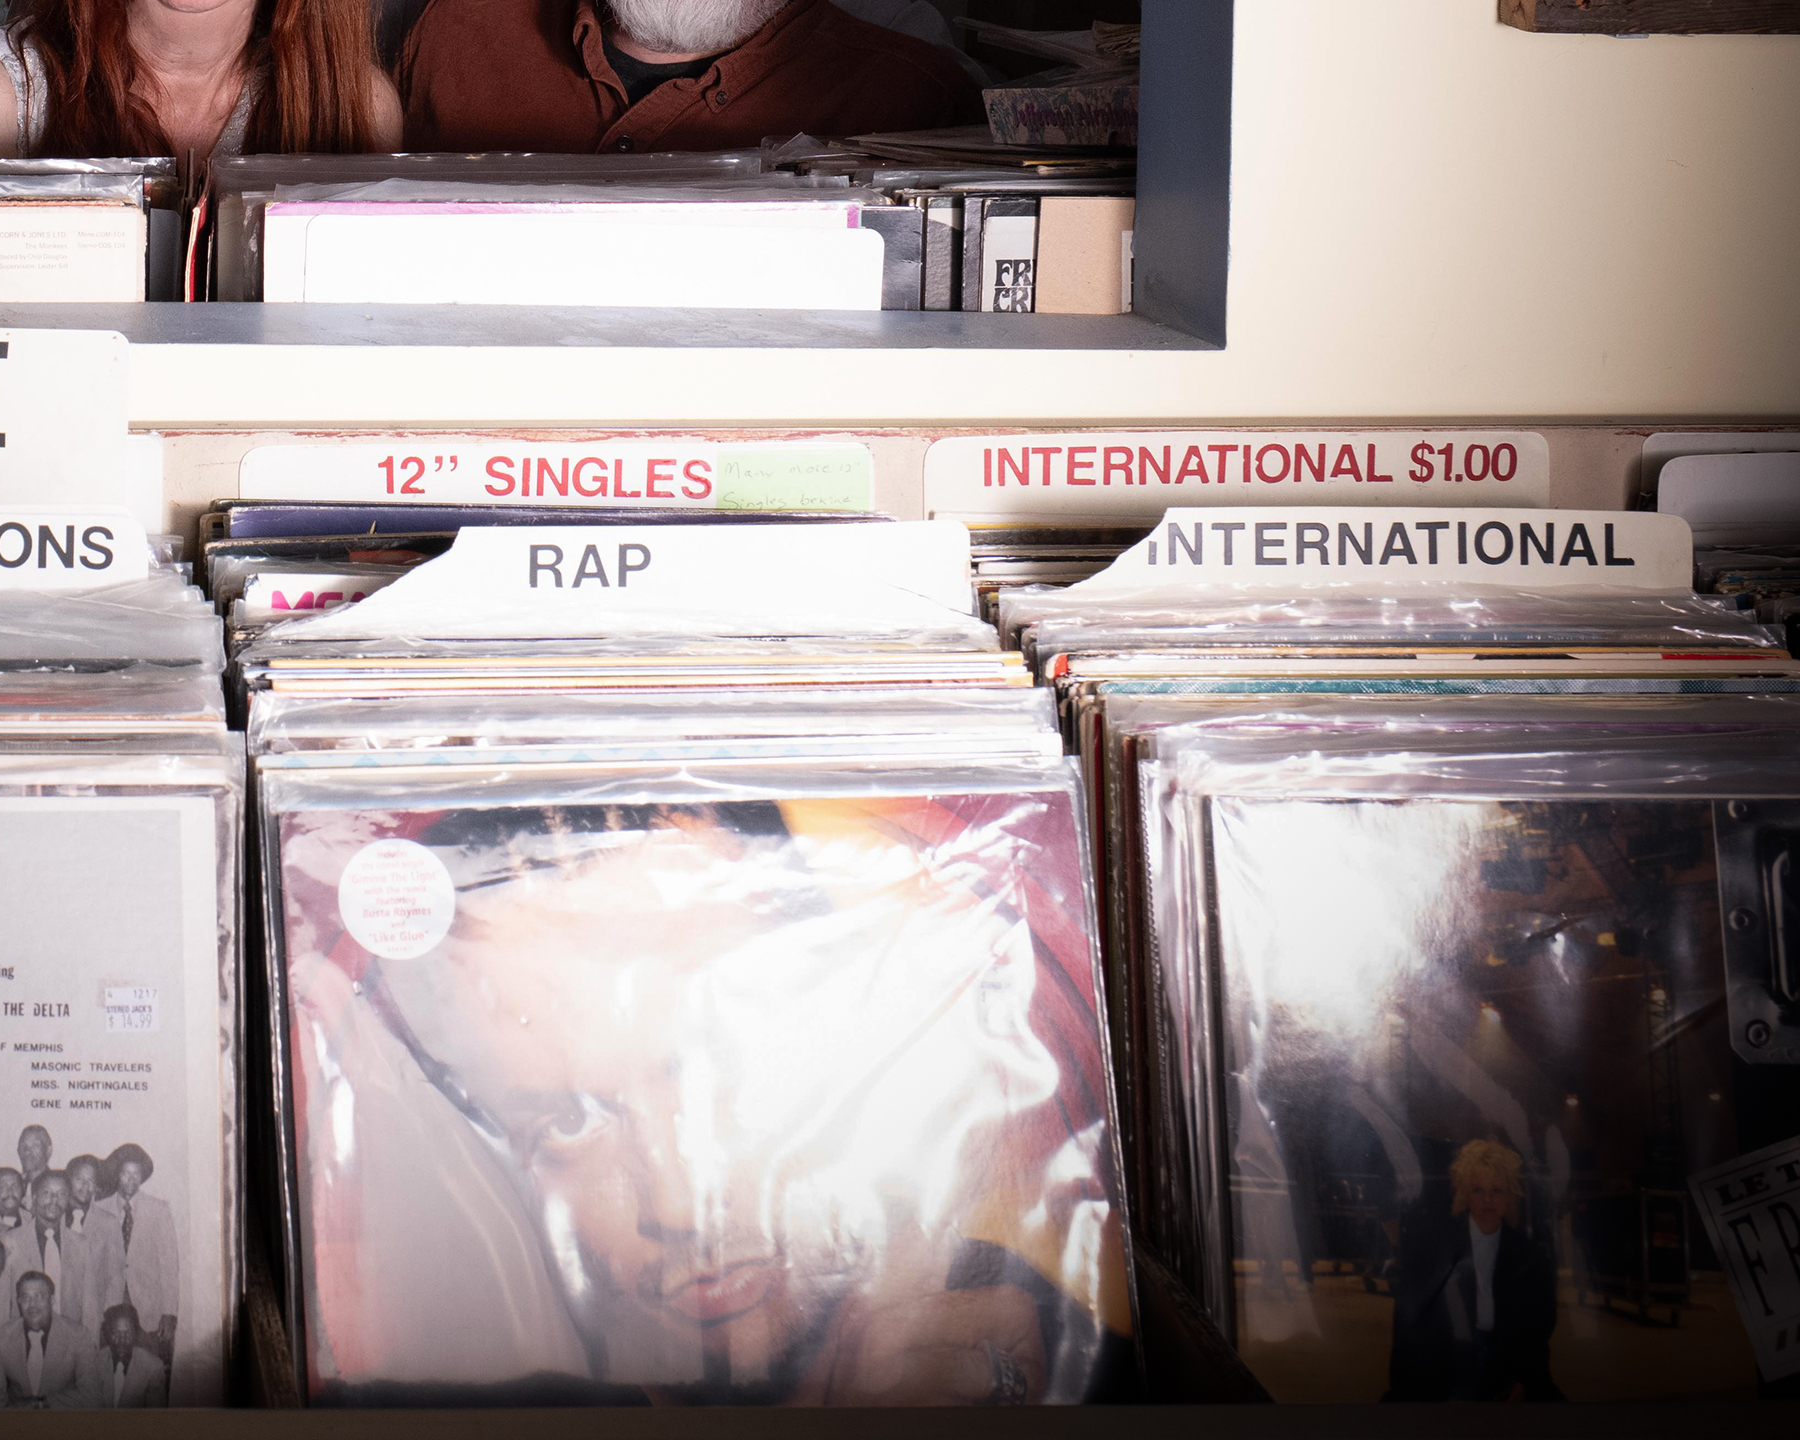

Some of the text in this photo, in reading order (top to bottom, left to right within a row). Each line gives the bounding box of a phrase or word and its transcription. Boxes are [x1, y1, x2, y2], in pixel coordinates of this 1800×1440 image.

[724, 461, 775, 479] Many
[982, 440, 1519, 488] INTERNATIONAL $1.00
[484, 455, 713, 500] SINGLES
[722, 491, 787, 510] Singles
[1147, 520, 1636, 568] INTERNATIONAL
[527, 543, 652, 590] RAP
[390, 872, 407, 882] The
[375, 897, 417, 906] featuring
[362, 907, 432, 918] Busta Rhymes
[3, 1002, 25, 1017] THE
[33, 1003, 71, 1018] DELTA
[106, 1005, 152, 1014] STEREO JACK'S
[122, 1013, 152, 1029] 14.99
[14, 1043, 64, 1053] MEMPHIS
[31, 1062, 152, 1073] MASONIC TRAVELERS
[31, 1080, 148, 1091] MISS. NIGHTINGALES
[31, 1099, 112, 1110] GENE MARTIN
